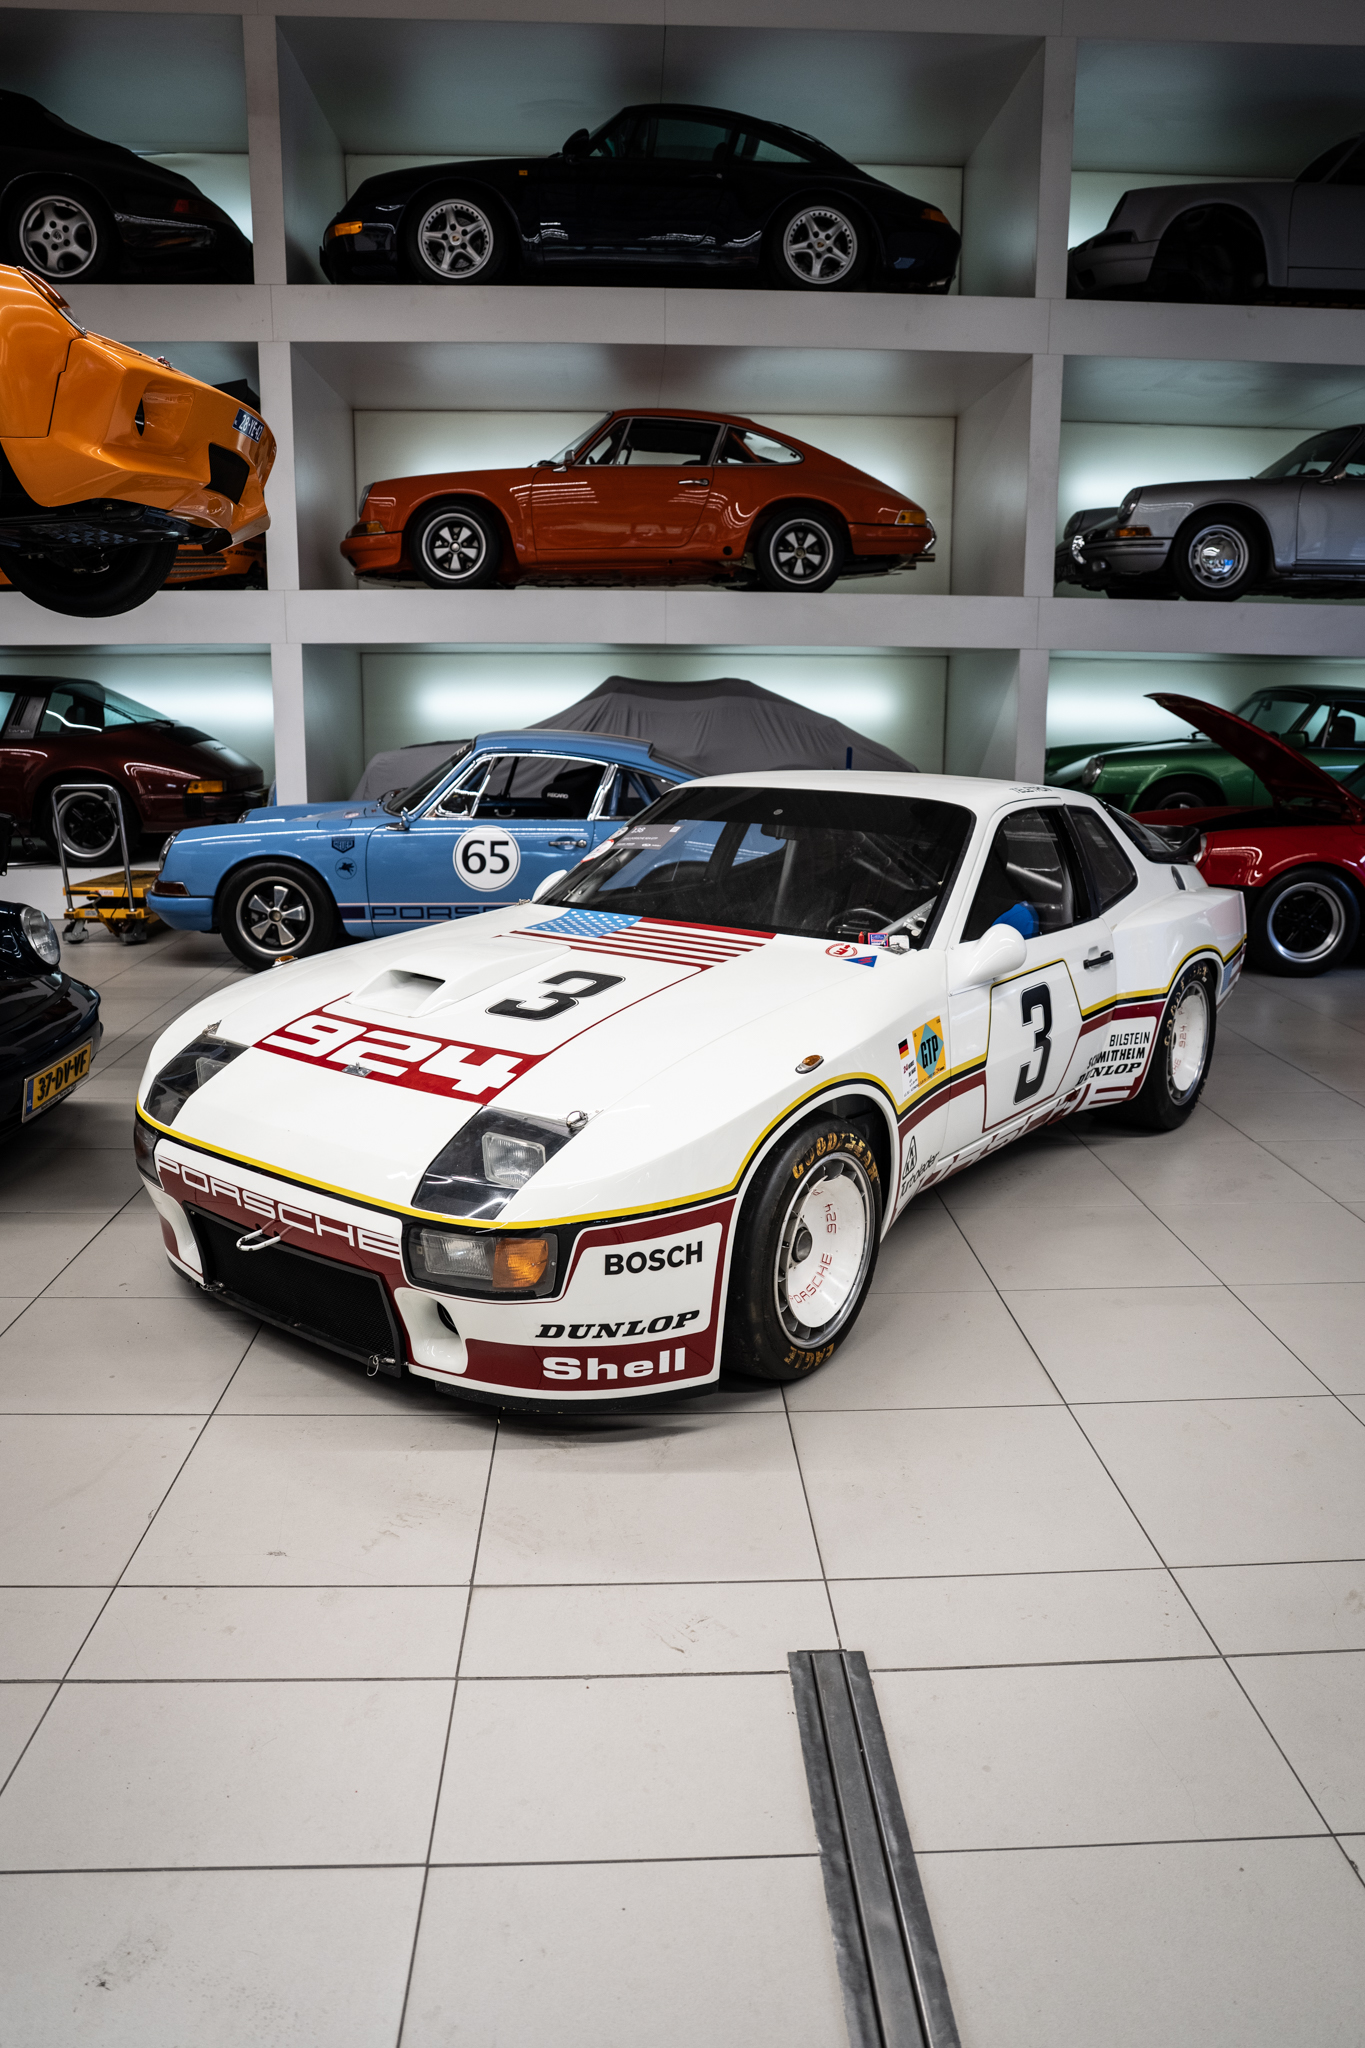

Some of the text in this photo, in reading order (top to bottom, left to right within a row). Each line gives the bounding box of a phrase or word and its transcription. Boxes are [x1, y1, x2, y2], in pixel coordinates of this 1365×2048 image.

[461, 839, 510, 875] 65
[485, 969, 626, 1021] 3
[920, 1034, 939, 1070] GTP
[1013, 981, 1053, 1106] 3
[1109, 1031, 1151, 1047] BILSTEIN
[1178, 1024, 1187, 1048] 924
[261, 1014, 524, 1096] 924
[37, 1049, 88, 1102] 37-DV-VF
[1075, 1062, 1142, 1087] DUNLOP
[158, 1155, 401, 1260] PORSCHE
[824, 1203, 837, 1234] 924
[604, 1240, 703, 1275] BOSCH
[535, 1309, 700, 1340] DUNLOP
[542, 1347, 686, 1381] Shell
